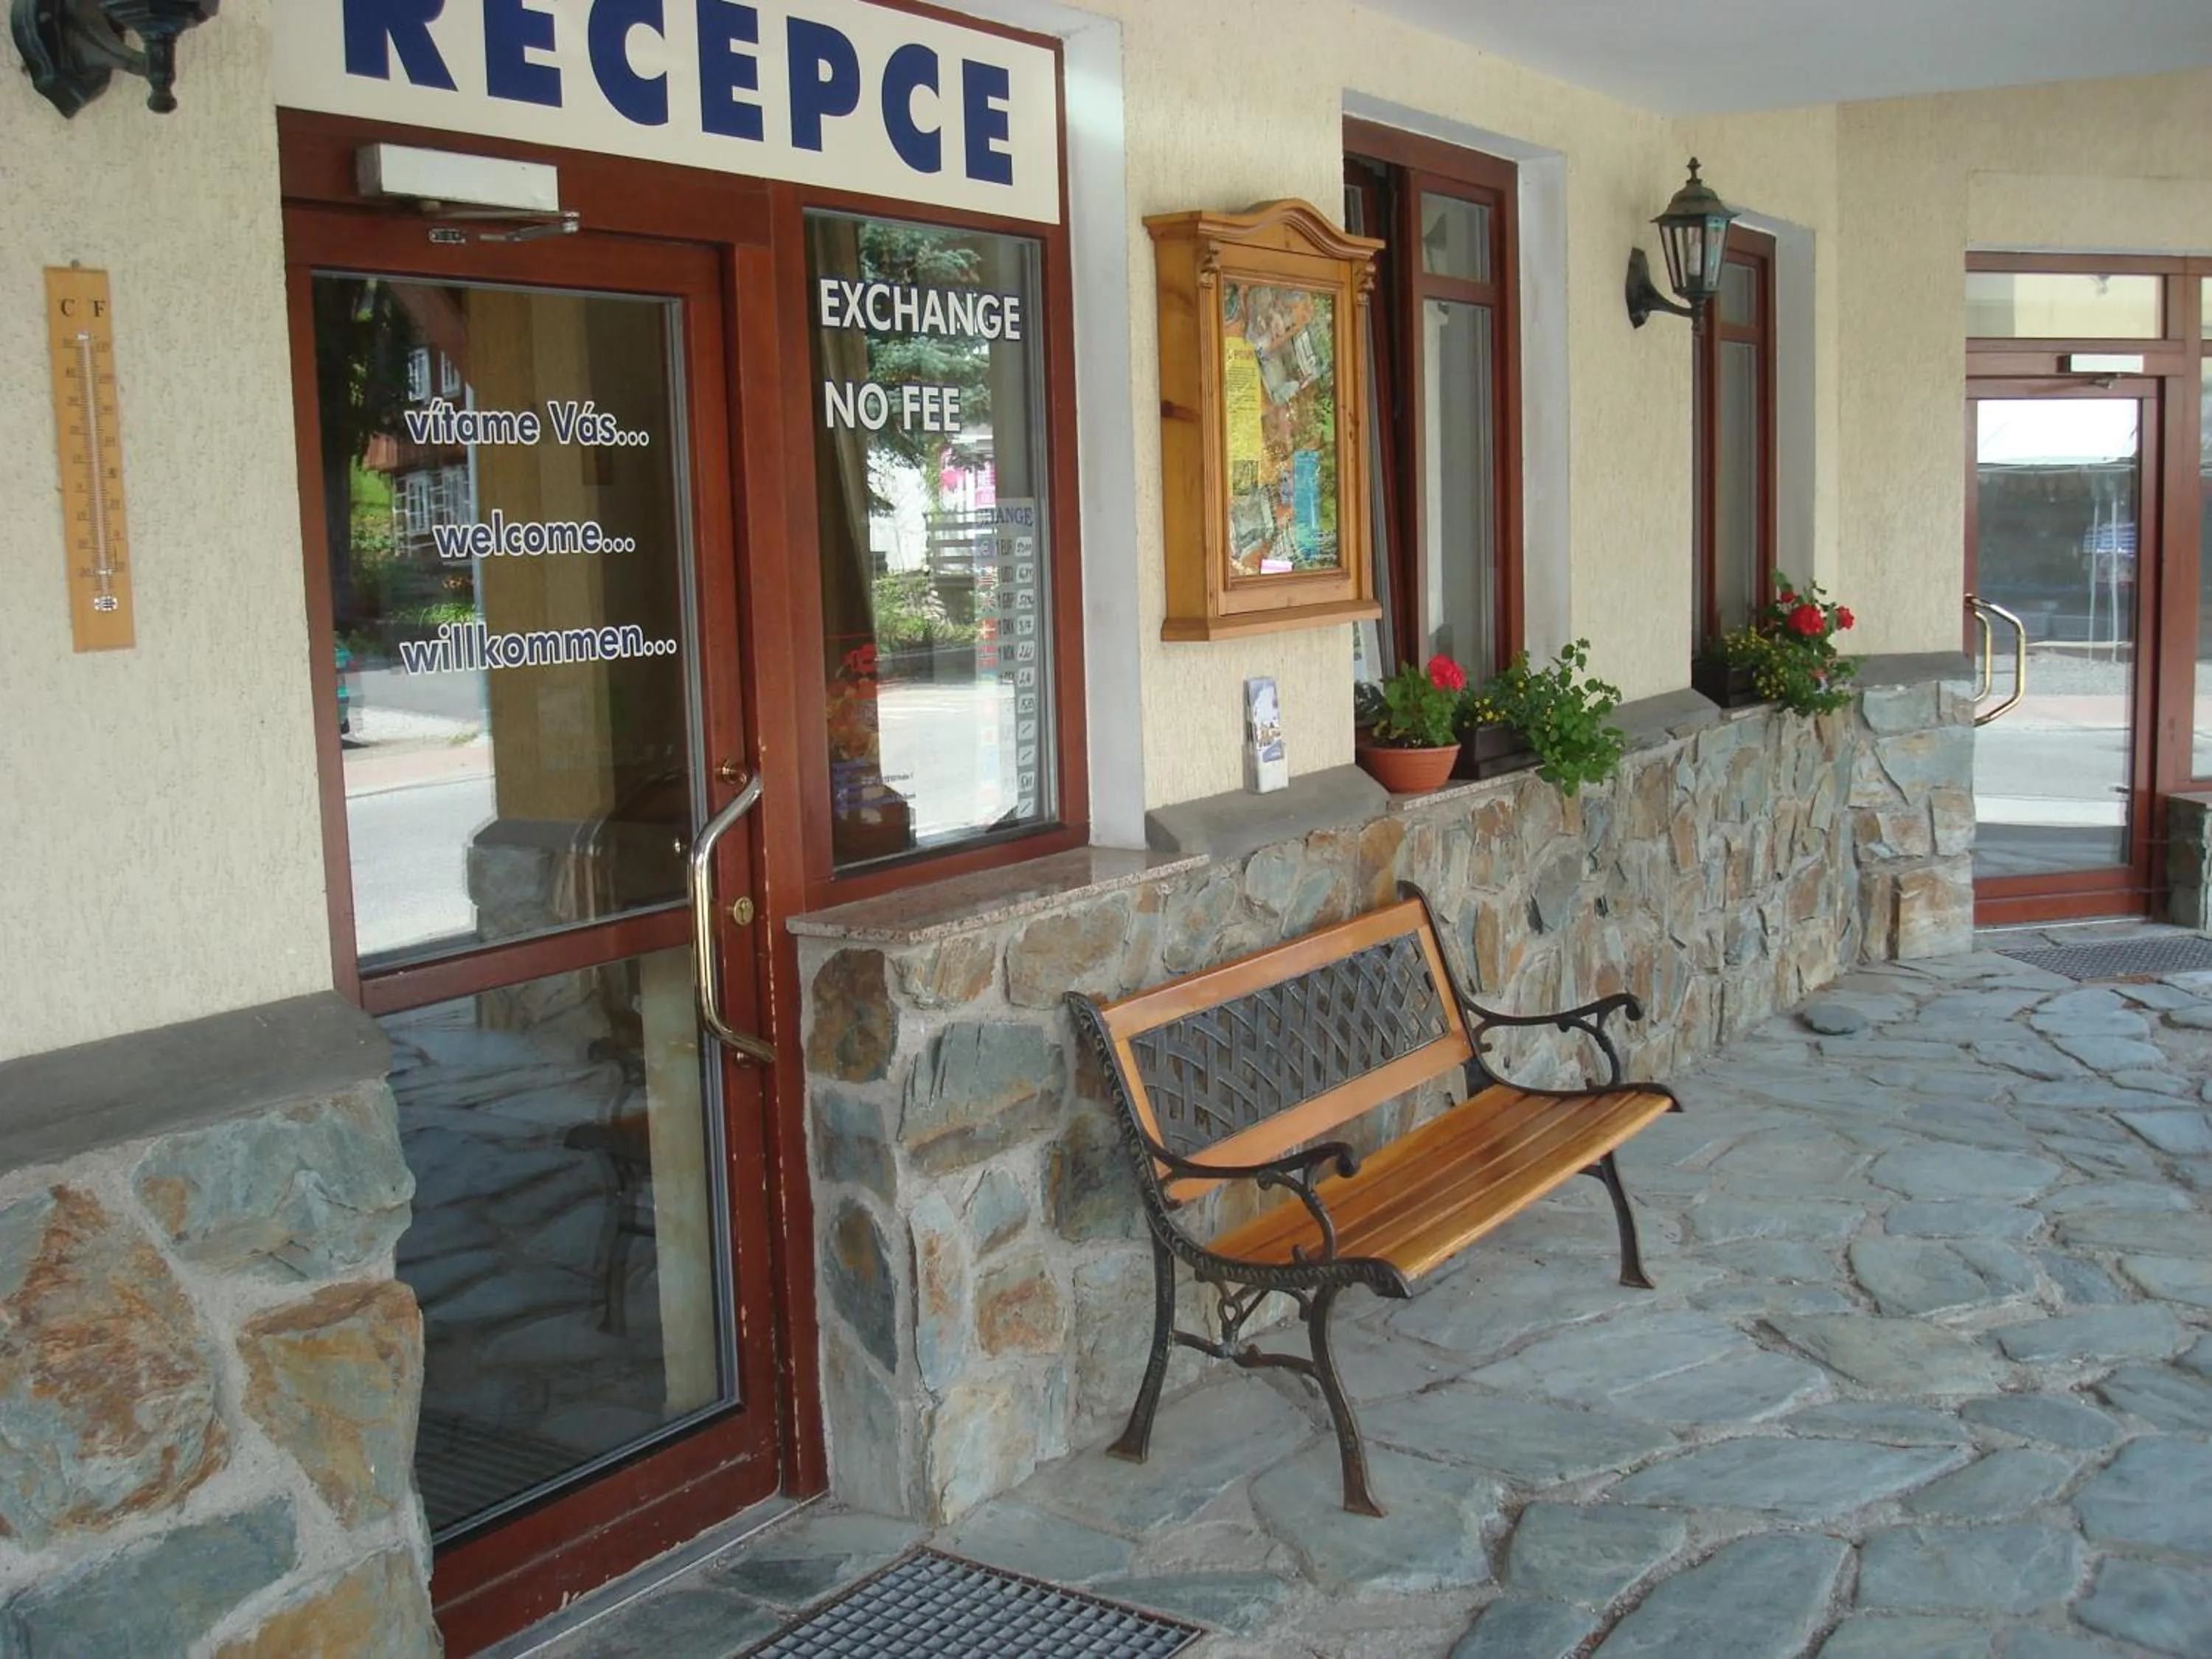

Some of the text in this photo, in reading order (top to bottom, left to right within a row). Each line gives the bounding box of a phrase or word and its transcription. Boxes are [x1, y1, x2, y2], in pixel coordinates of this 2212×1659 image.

[344, 0, 1013, 186] RECEPCE
[94, 299, 105, 317] F
[819, 277, 1021, 341] EXCHANGE
[405, 397, 650, 447] vítame Vás...
[824, 380, 961, 432] NO FEE
[432, 509, 636, 558] welcome...
[976, 507, 1033, 528] ANGE
[399, 622, 678, 675] willkommen...
